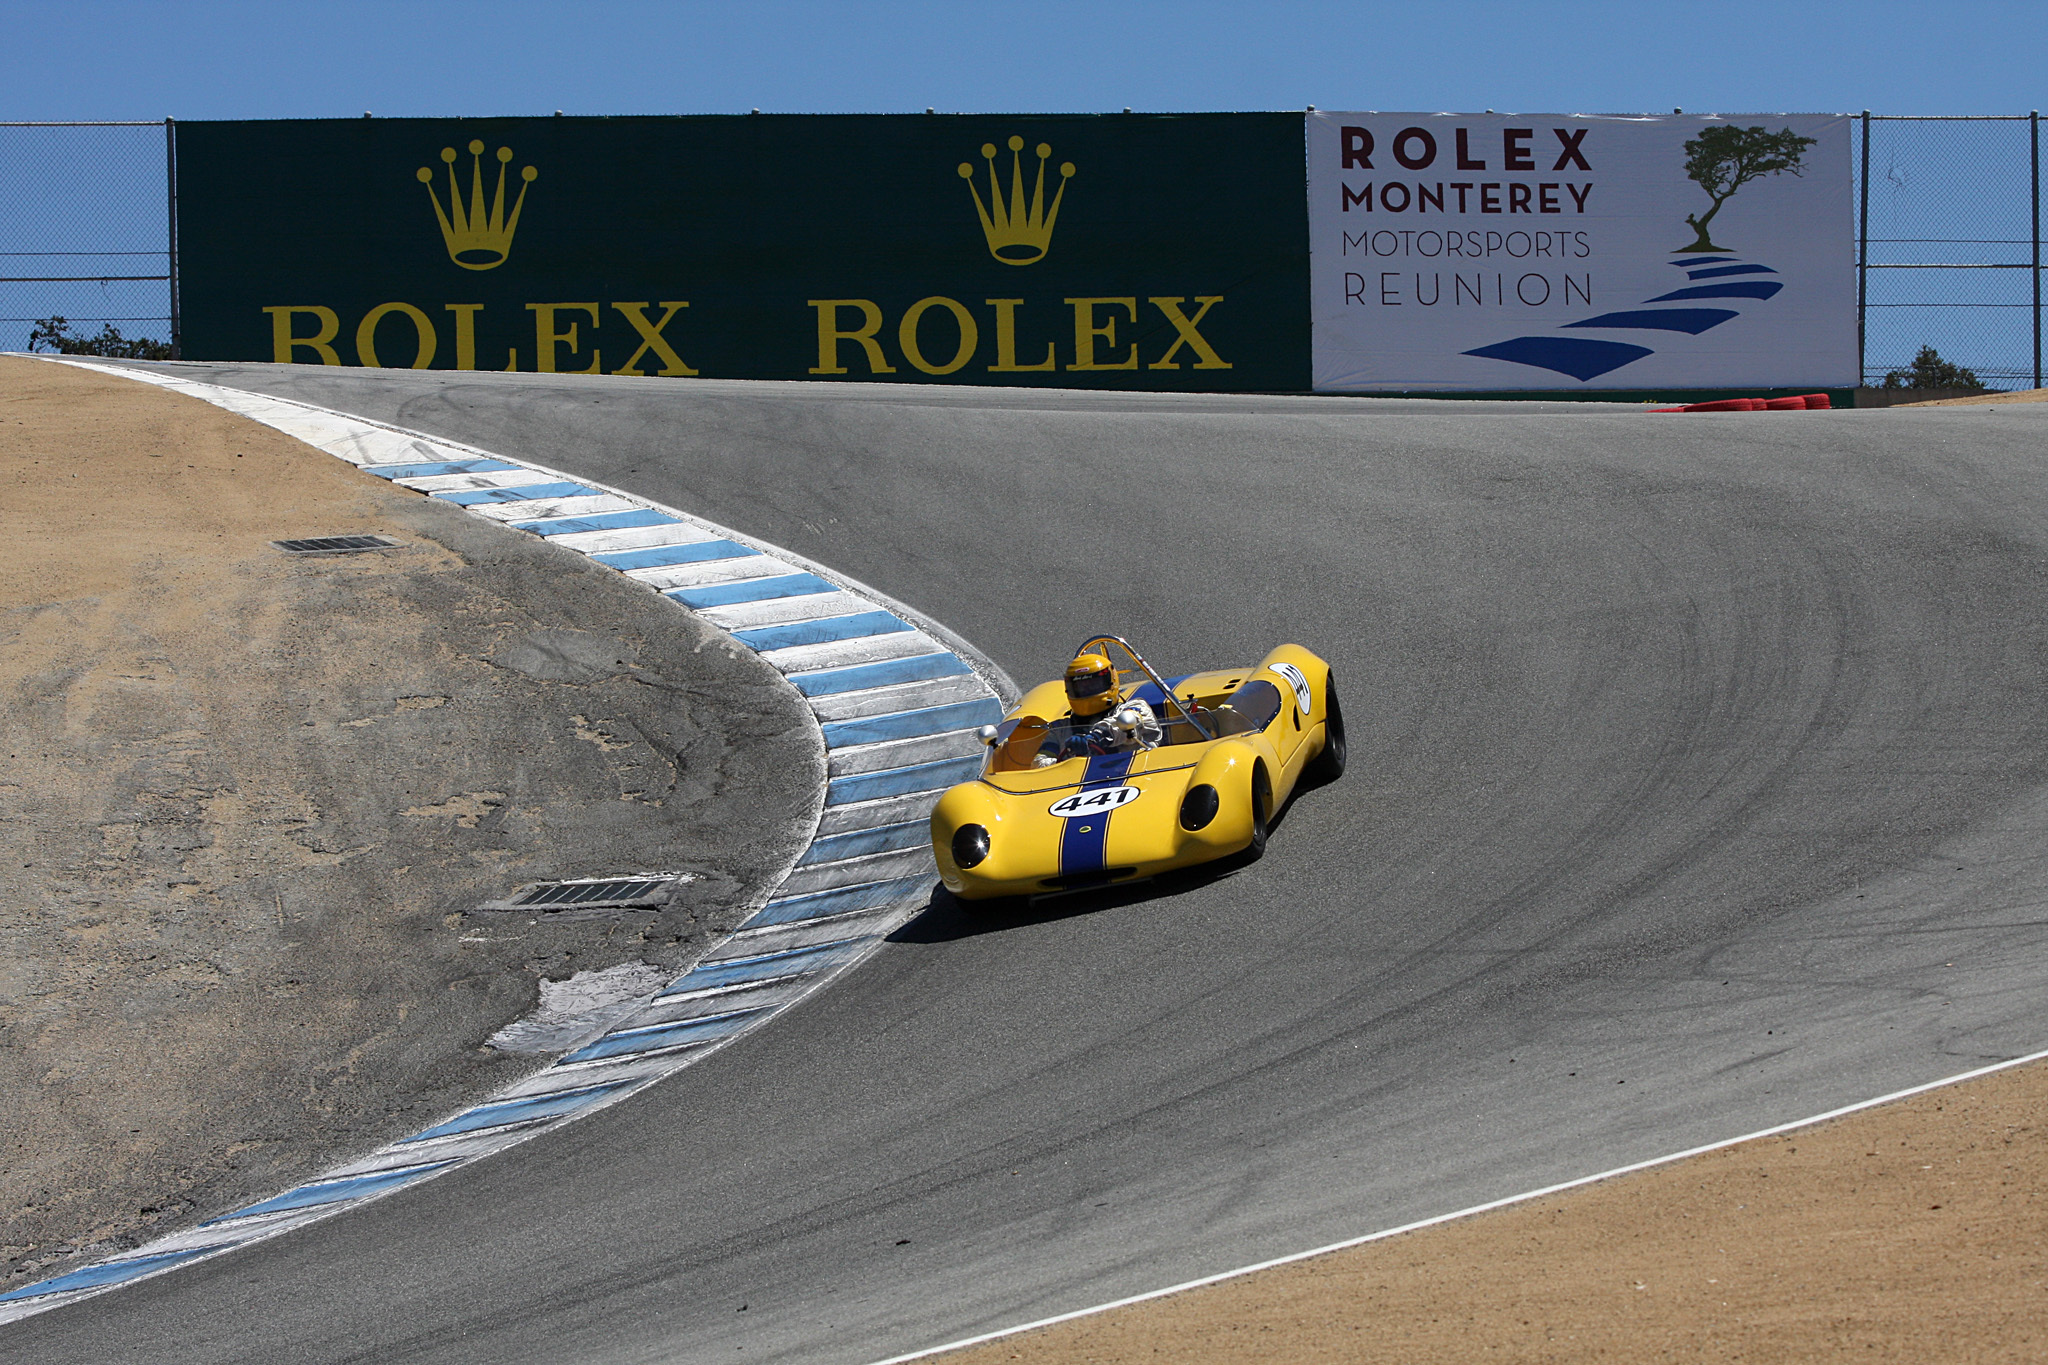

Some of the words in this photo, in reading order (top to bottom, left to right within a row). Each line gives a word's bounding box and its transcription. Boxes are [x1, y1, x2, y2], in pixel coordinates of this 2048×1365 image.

[1340, 126, 1593, 172] ROLEX
[1341, 181, 1594, 214] MONTEREY
[1342, 229, 1591, 259] MOTORSPORTS
[1344, 271, 1591, 307] REUNION
[262, 301, 699, 376] ROLEX
[807, 295, 1233, 375] ROLEX
[1053, 788, 1131, 812] 441
